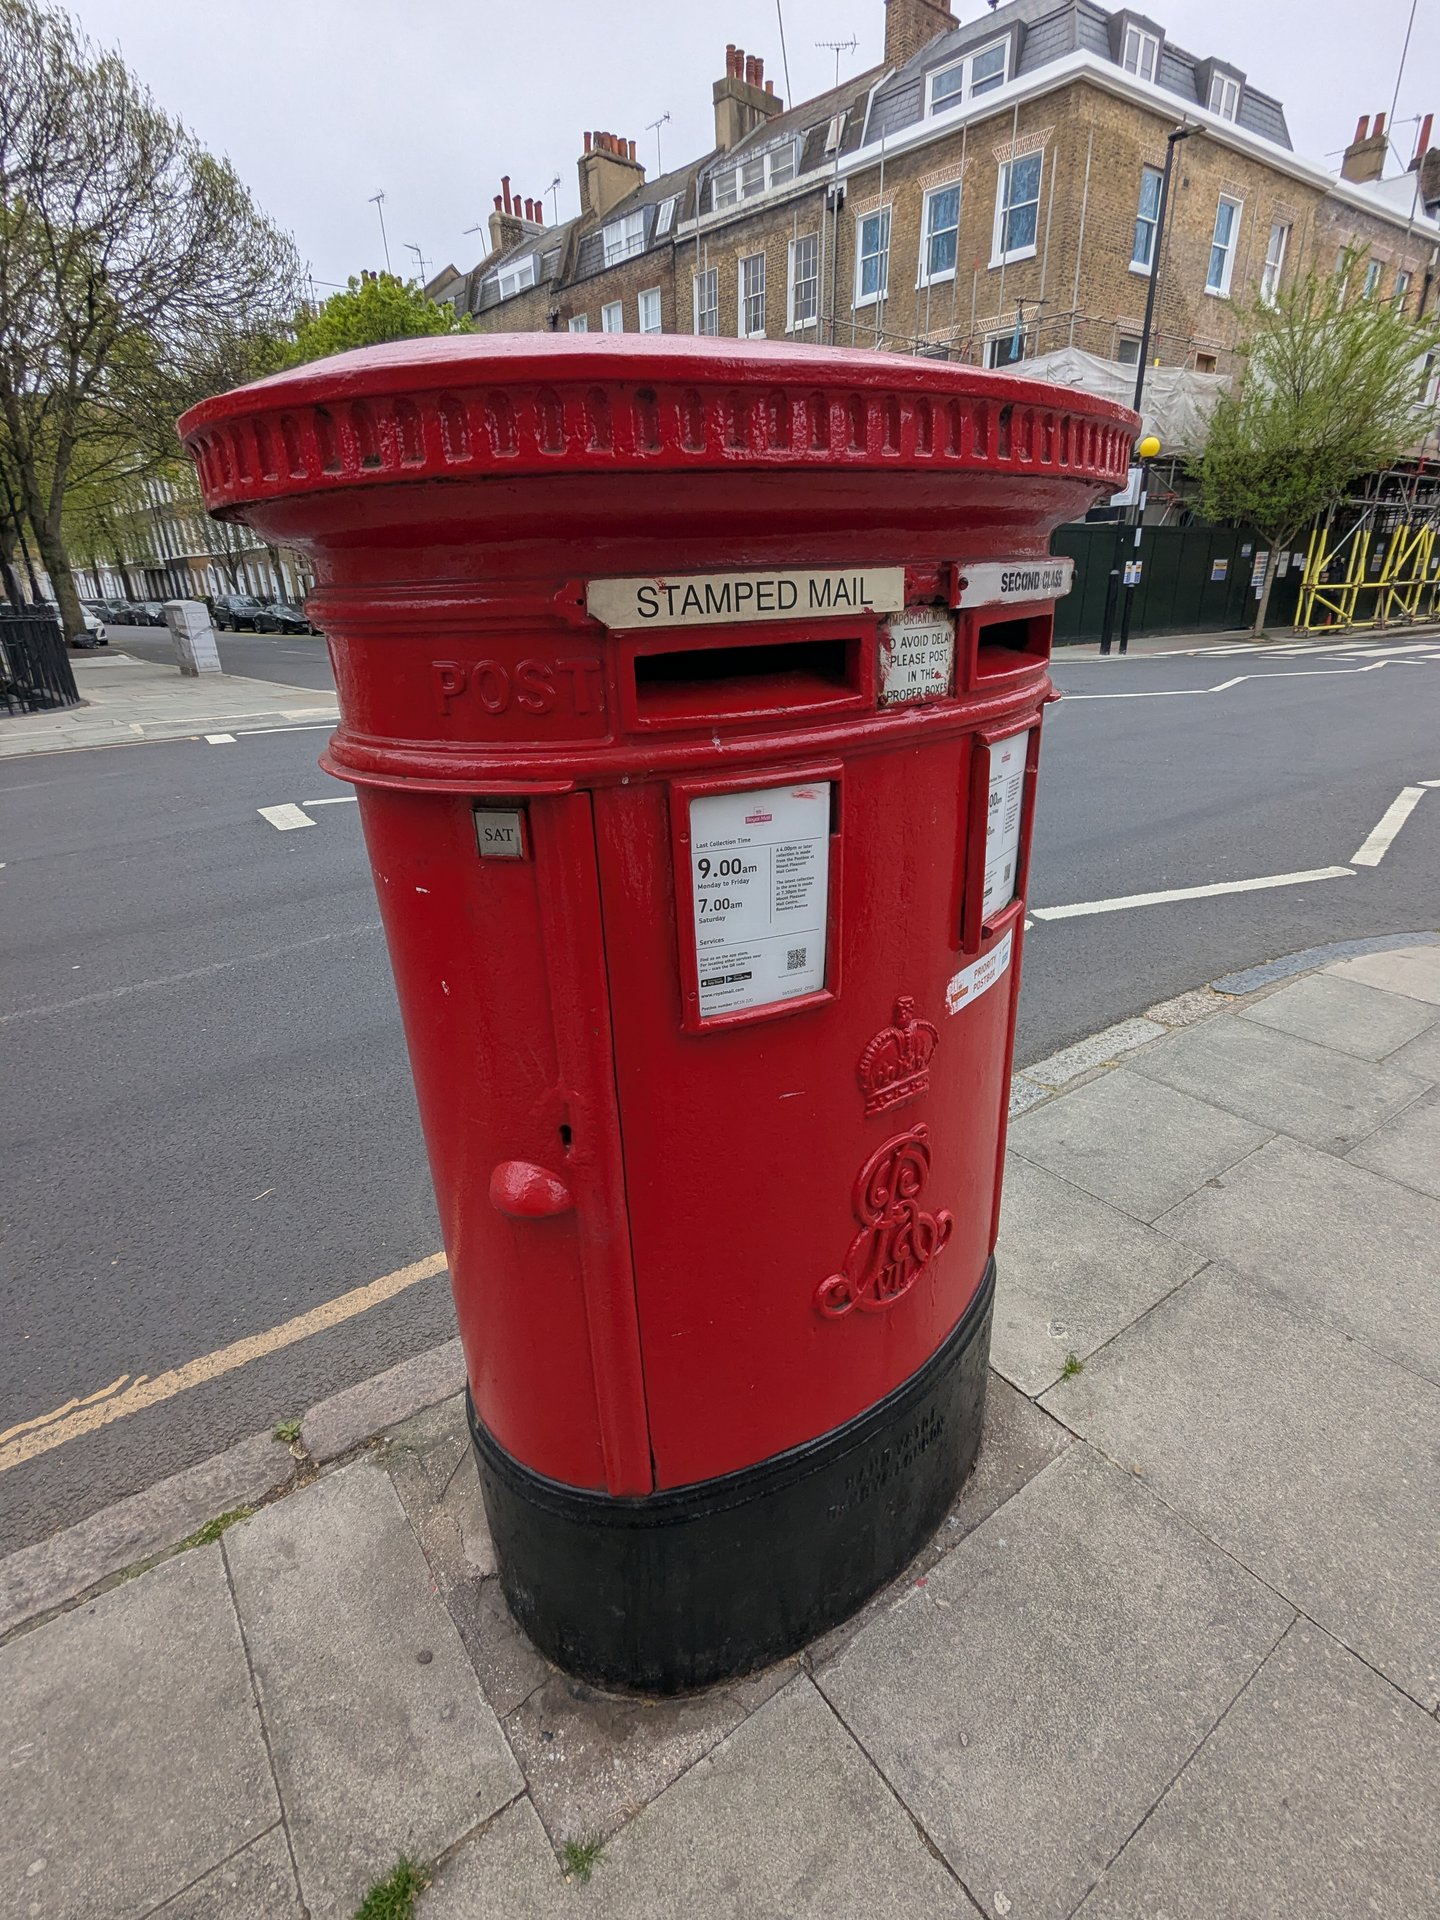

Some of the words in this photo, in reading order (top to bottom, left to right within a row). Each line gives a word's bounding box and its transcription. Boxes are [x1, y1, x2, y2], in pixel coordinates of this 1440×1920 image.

[1001, 571, 1040, 592] SECOND
[1042, 569, 1063, 589] CLASS
[636, 580, 798, 618] STAMPED
[808, 577, 874, 608] MAIL
[890, 611, 930, 627] IMPORTANT
[900, 634, 929, 649] AVOID
[890, 652, 926, 667] PLEASE
[929, 649, 948, 663] POST
[908, 670, 917, 682] IN
[920, 667, 935, 680] THE
[432, 659, 601, 716] POST
[886, 687, 923, 702] PROPER
[925, 682, 947, 696] BOXES
[484, 828, 514, 843] SAT
[709, 839, 736, 847] Collection
[697, 858, 757, 880] 9.00am
[697, 882, 721, 890] Monday
[730, 878, 750, 886] Friday
[698, 898, 743, 914] 7.00am
[698, 915, 726, 924] Saturday
[699, 936, 725, 946] Services
[973, 955, 997, 979] PRIORITY
[972, 968, 996, 993] POSTBOX
[701, 987, 745, 998] www.royalmail.com
